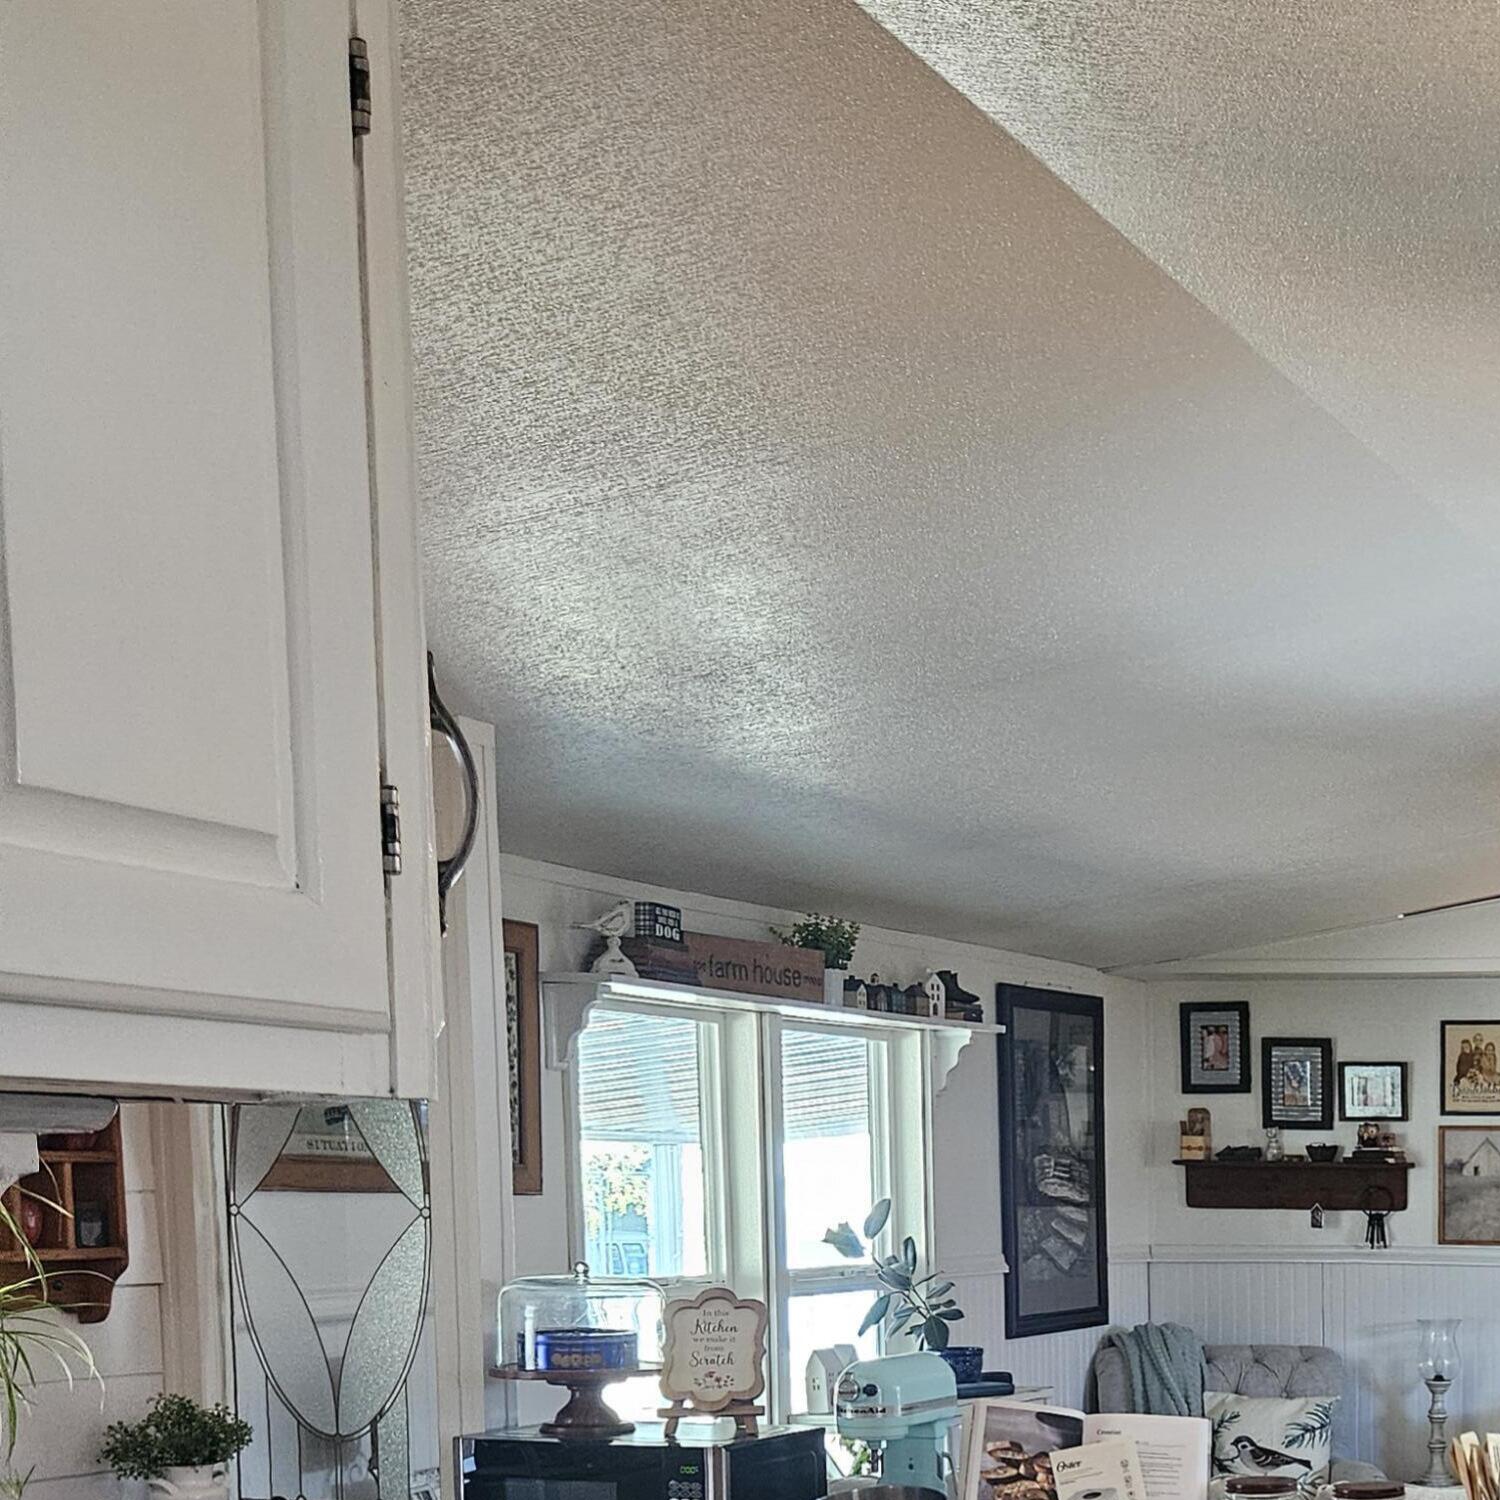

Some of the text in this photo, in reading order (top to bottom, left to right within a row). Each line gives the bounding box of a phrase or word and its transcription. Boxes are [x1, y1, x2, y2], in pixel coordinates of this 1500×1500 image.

[655, 923, 681, 942] DOG
[709, 953, 749, 981] farm
[753, 957, 802, 988] house
[690, 1318, 738, 1336] Kitchen
[689, 1350, 735, 1368] Scratch
